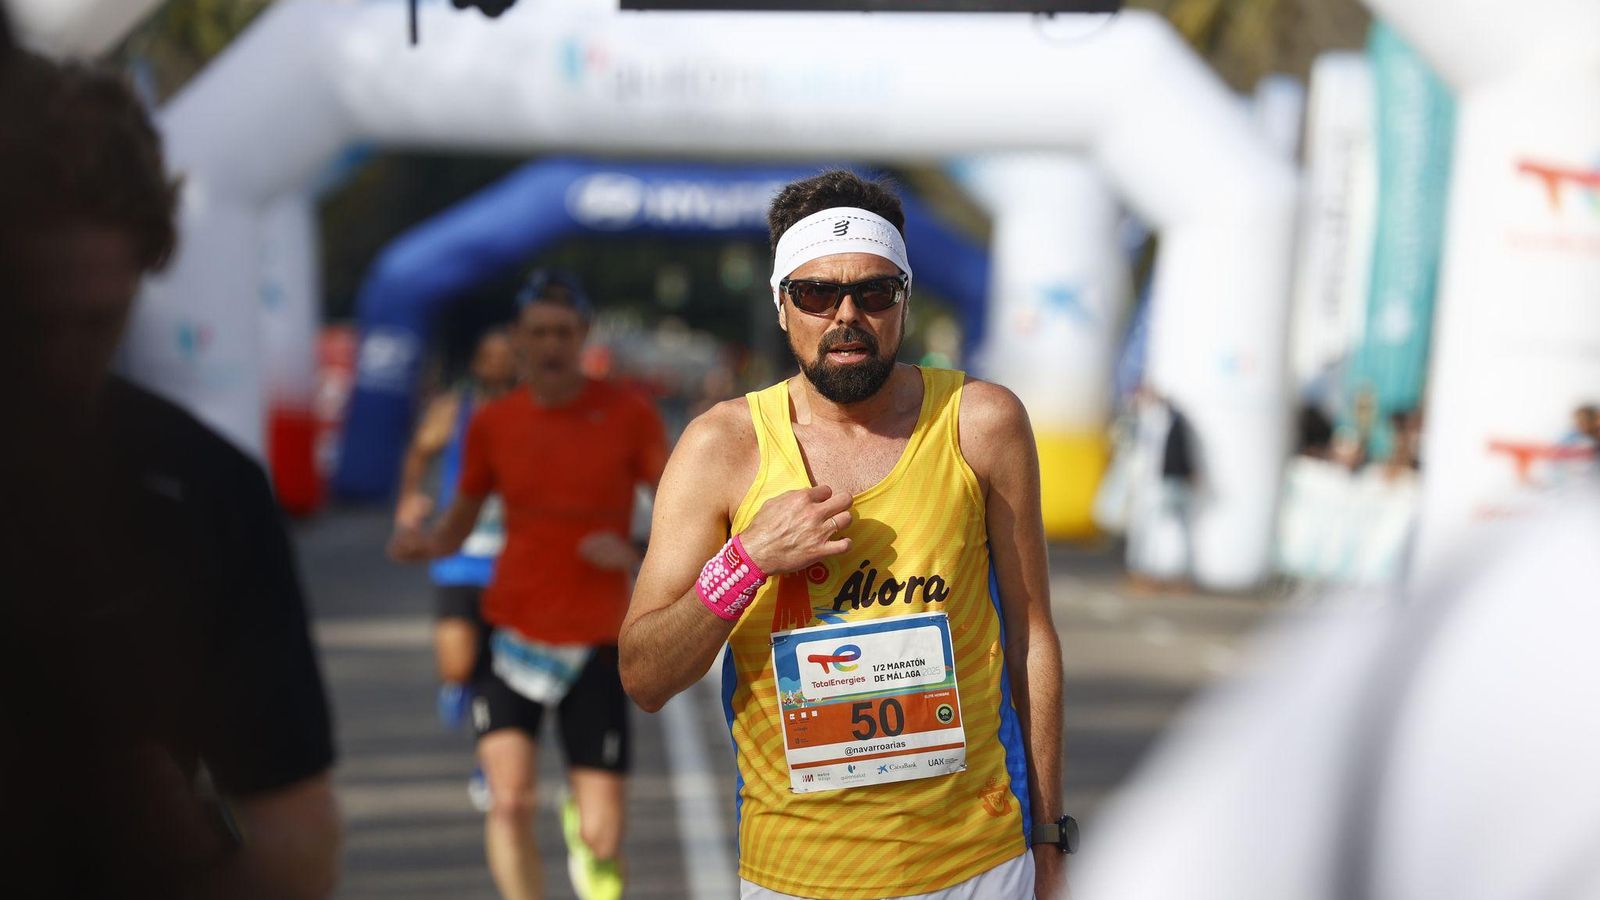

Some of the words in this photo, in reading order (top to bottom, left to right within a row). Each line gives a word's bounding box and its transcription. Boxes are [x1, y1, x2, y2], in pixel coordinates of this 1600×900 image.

[832, 560, 950, 610] Álora
[872, 664, 886, 672] 1/2
[887, 658, 926, 670] MARATÓN
[811, 675, 866, 689] TotalEnergies
[874, 674, 886, 683] DE
[886, 670, 921, 681] MÁLAGA
[922, 666, 941, 676] 2025
[851, 698, 905, 741] 50
[844, 741, 907, 757] @navarroarias
[888, 762, 917, 771] CaixaBank
[927, 758, 945, 767] UAX
